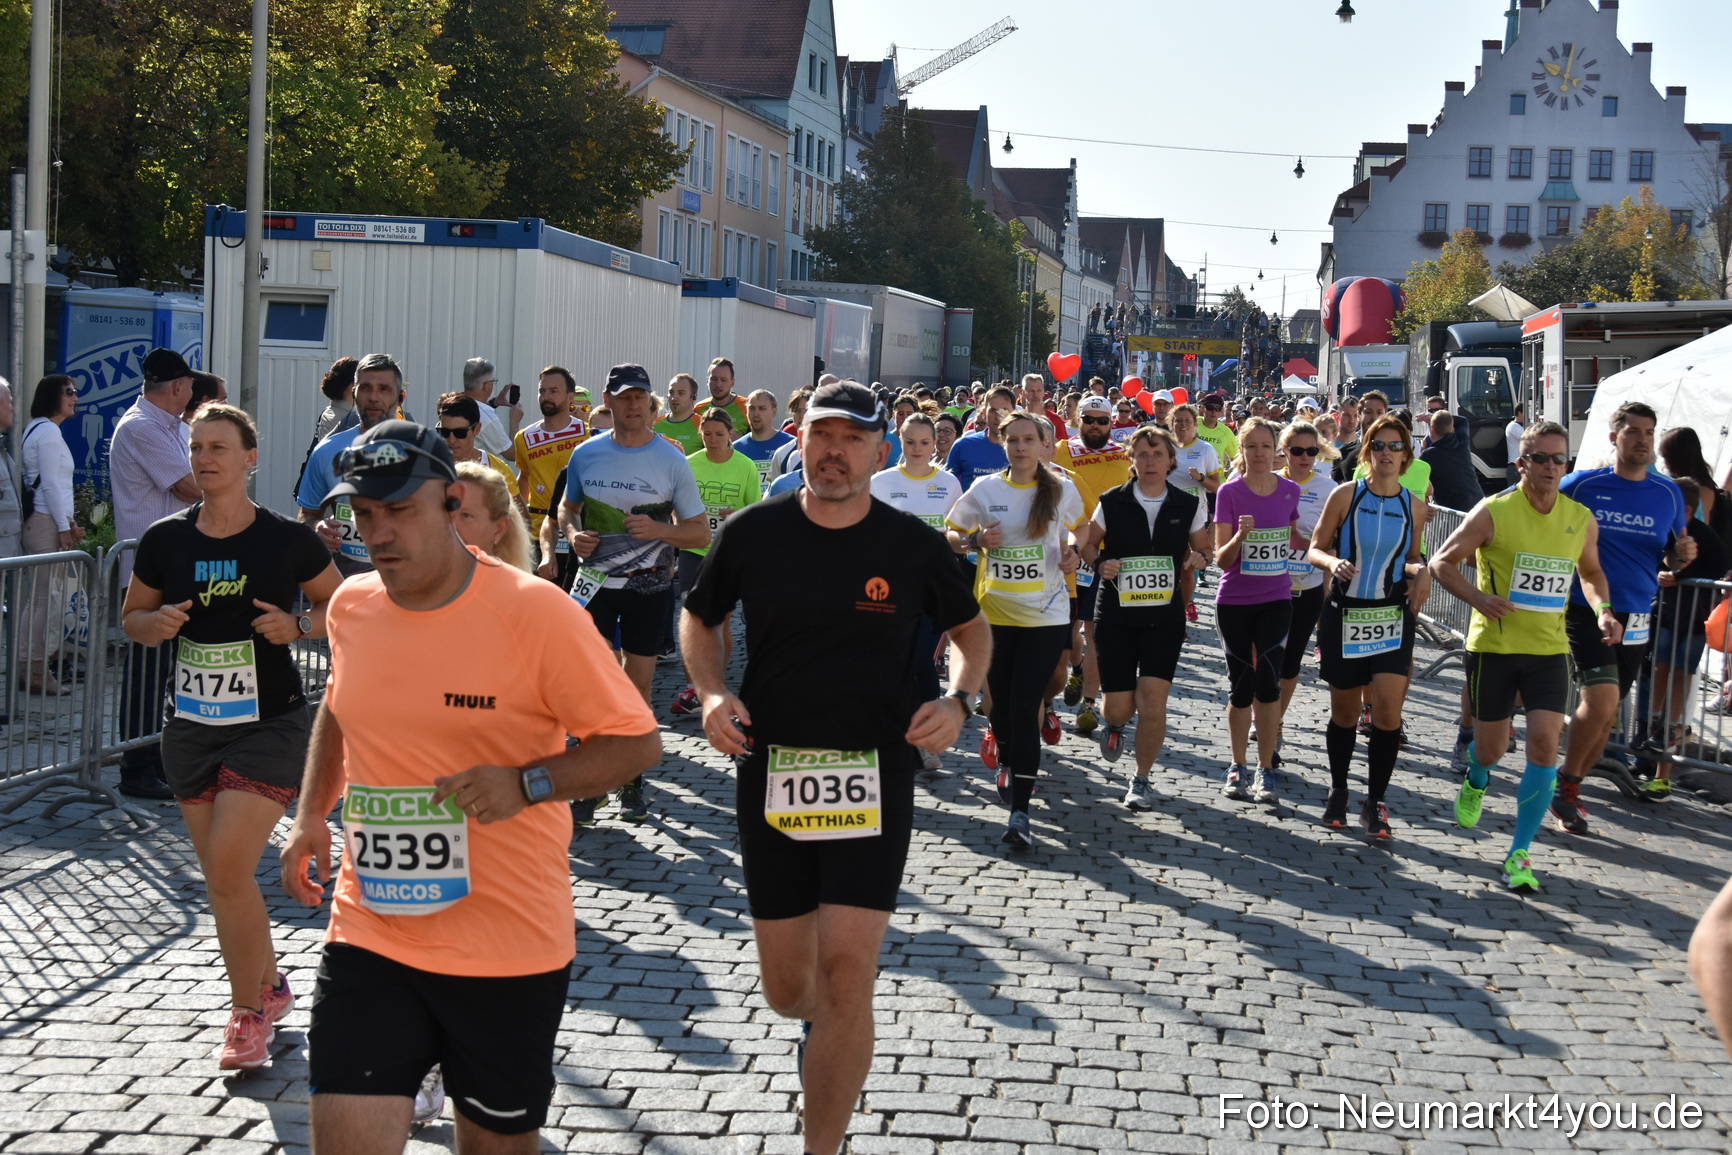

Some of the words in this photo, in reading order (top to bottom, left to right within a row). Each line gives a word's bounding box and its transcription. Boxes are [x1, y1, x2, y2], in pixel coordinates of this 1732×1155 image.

[373, 224, 392, 232] 08141
[408, 226, 416, 234] 80
[89, 314, 113, 324] 08141
[119, 316, 134, 325] 536
[135, 317, 145, 327] 80
[1163, 340, 1203, 351] START
[528, 447, 554, 461] MAX
[557, 439, 583, 452] BÖG
[1072, 457, 1101, 467] MAX
[584, 479, 636, 491] RAIL.ONE
[1595, 509, 1655, 528] SYSCAD
[1248, 530, 1287, 540] BOCK
[350, 546, 368, 556] TOL
[990, 548, 1037, 559] BOCK
[1248, 543, 1287, 560] 2616
[194, 560, 238, 582] RUN
[1122, 560, 1168, 570] BOCK
[1248, 562, 1285, 571] SUSANNE
[1288, 563, 1307, 571] TINA
[1521, 556, 1568, 571] BOCK
[992, 563, 1038, 580] 1396
[1125, 573, 1169, 589] 1038
[1518, 573, 1565, 594] 2812
[199, 573, 248, 607] fast
[1130, 593, 1164, 601] ANDREA
[1348, 609, 1396, 621] BOCK
[1350, 623, 1395, 641] 2591
[1358, 642, 1387, 652] SILVIA
[179, 645, 244, 666] BOCK
[181, 668, 246, 698] 2174
[444, 693, 496, 709] THULE
[199, 703, 221, 716] EVI
[777, 749, 868, 768] BOCK
[782, 774, 867, 806] 1036
[349, 791, 448, 820] BOCK
[778, 813, 867, 828] MATTHIAS
[353, 831, 451, 871] 2539
[364, 882, 443, 900] MARCOS
